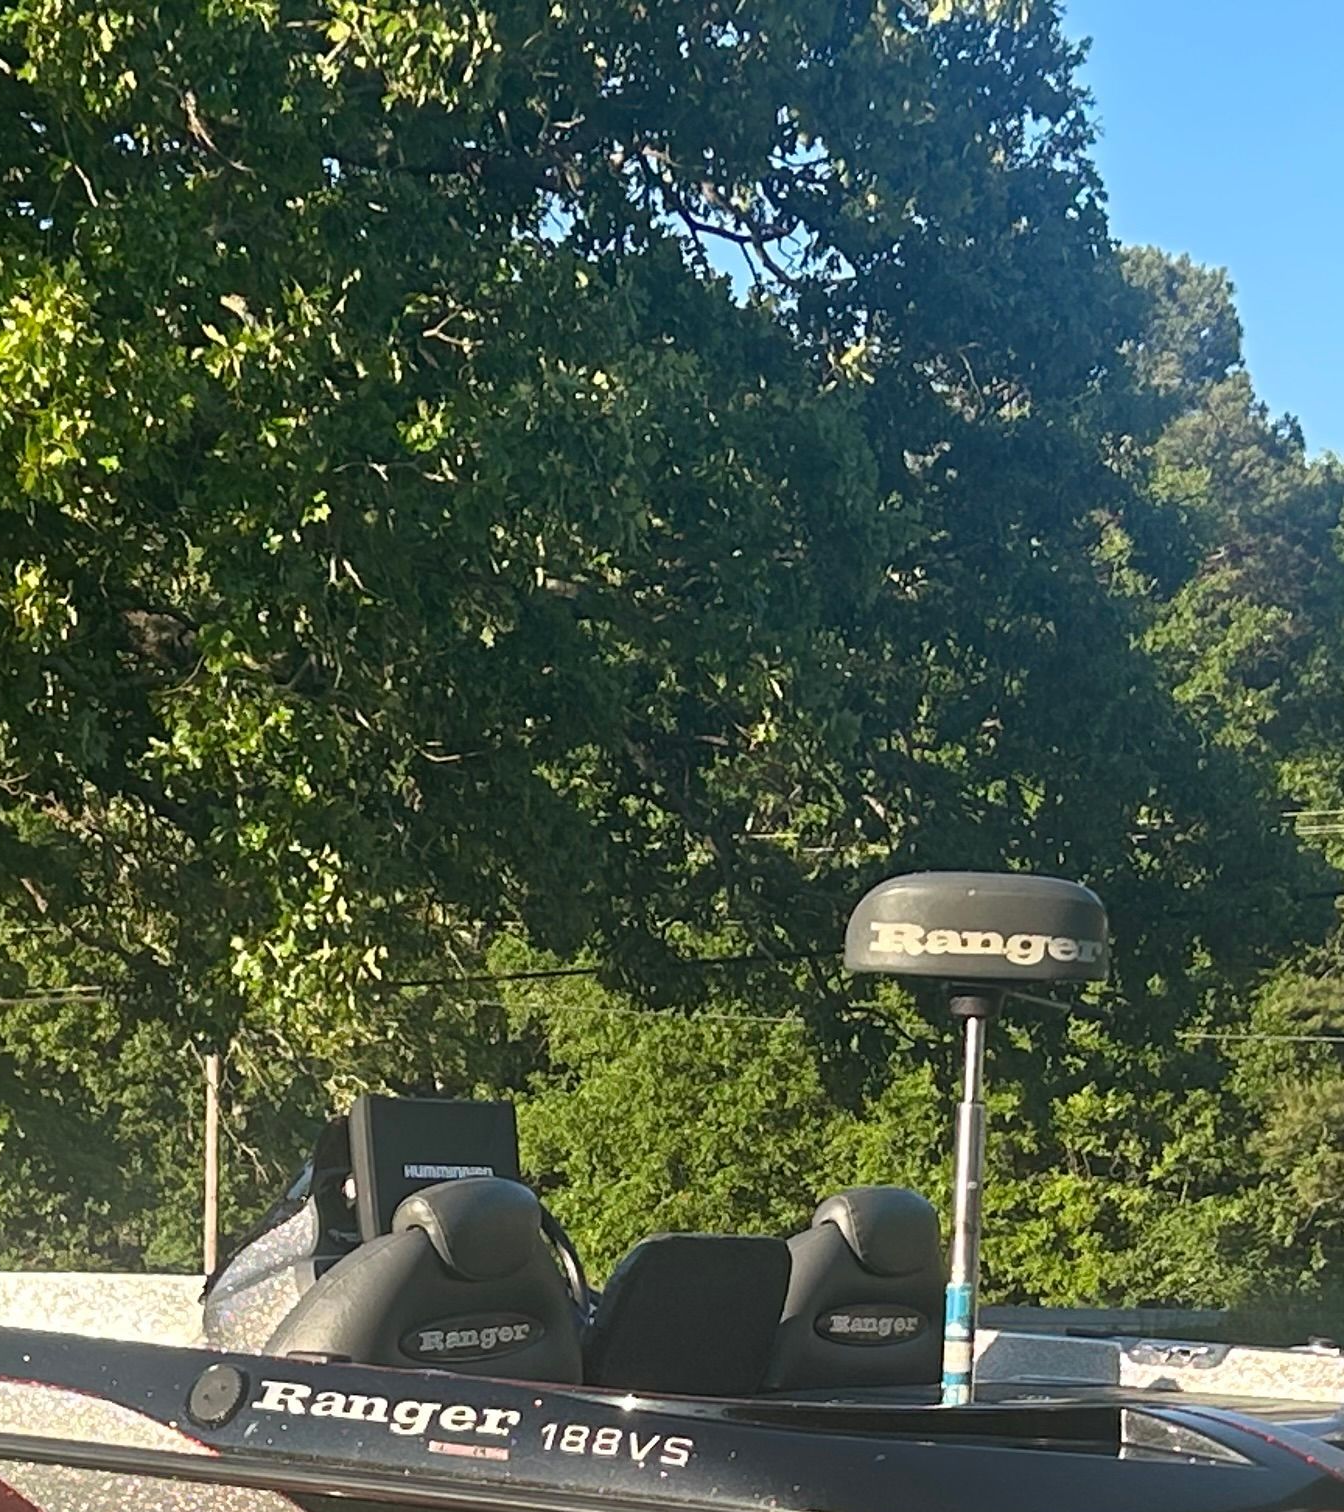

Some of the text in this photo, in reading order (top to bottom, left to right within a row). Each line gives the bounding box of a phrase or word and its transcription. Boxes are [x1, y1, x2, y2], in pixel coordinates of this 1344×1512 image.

[869, 921, 1103, 966] Ranger
[419, 1323, 530, 1351] Ranger
[829, 1315, 918, 1336] Ranger
[252, 1380, 520, 1436] Ranger
[541, 1423, 693, 1468] 188VS
